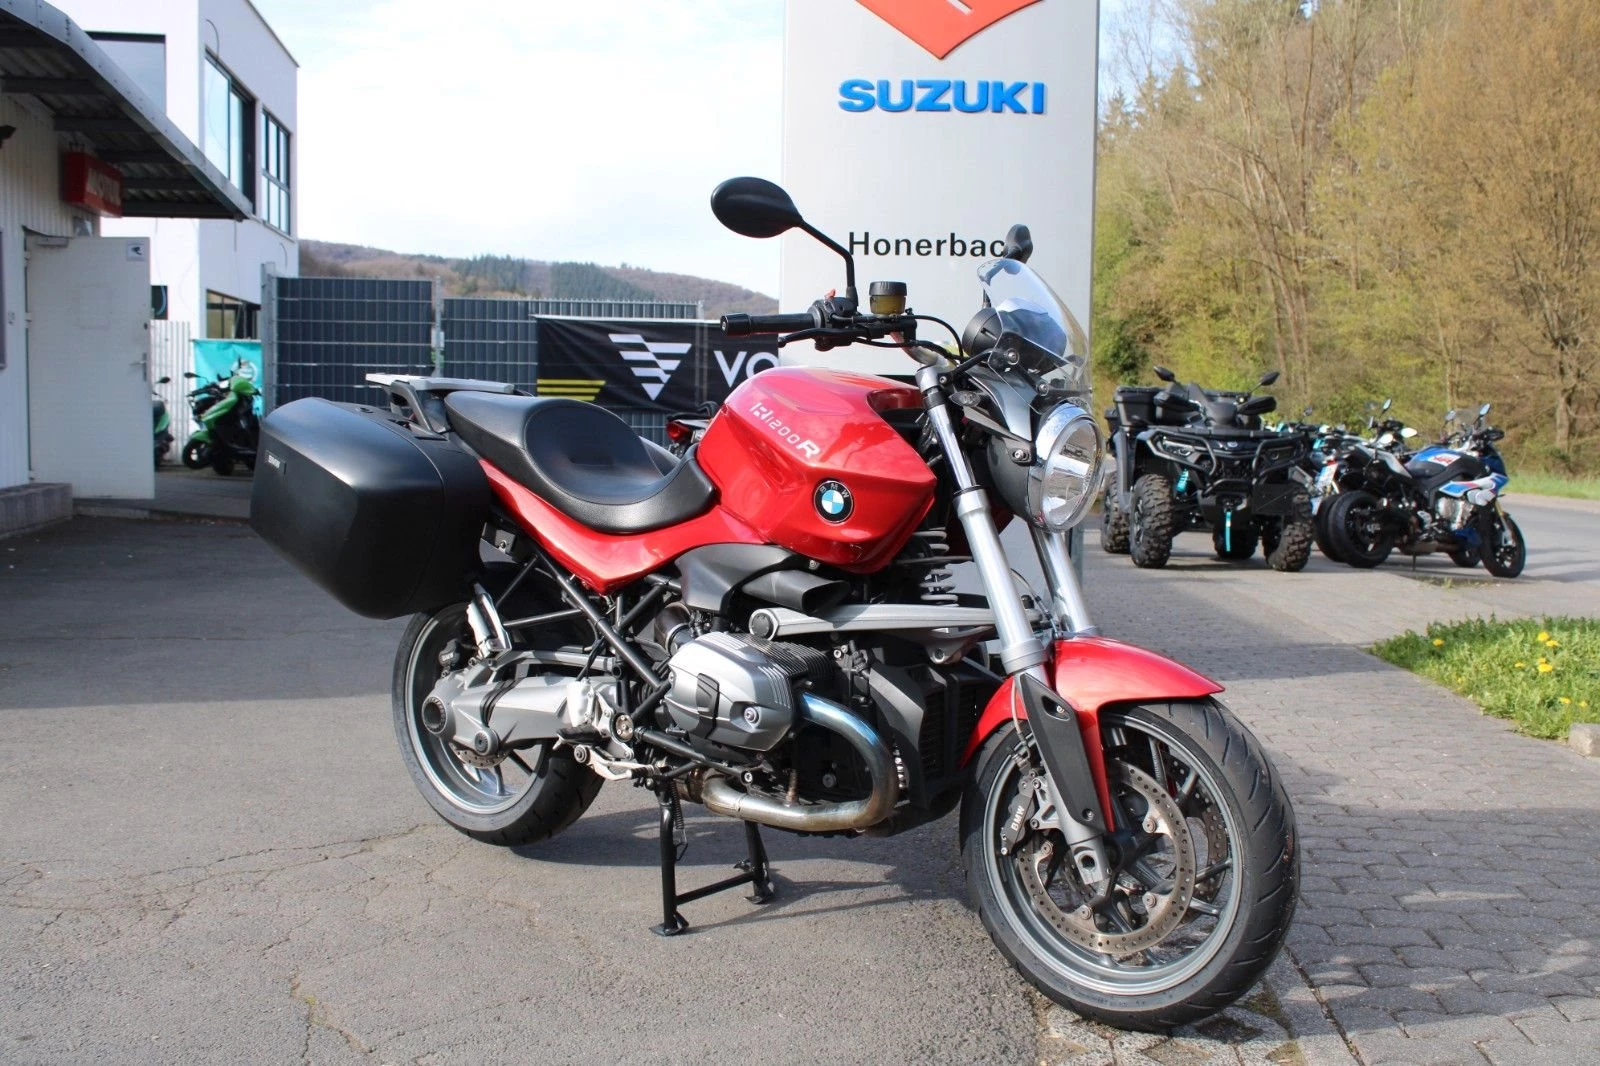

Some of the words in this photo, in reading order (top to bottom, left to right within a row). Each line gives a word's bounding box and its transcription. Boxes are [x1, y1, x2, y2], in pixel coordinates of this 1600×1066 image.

[838, 79, 1046, 114] SUZUKI
[849, 231, 1005, 258] Honerbac
[1010, 805, 1025, 832] BMW
